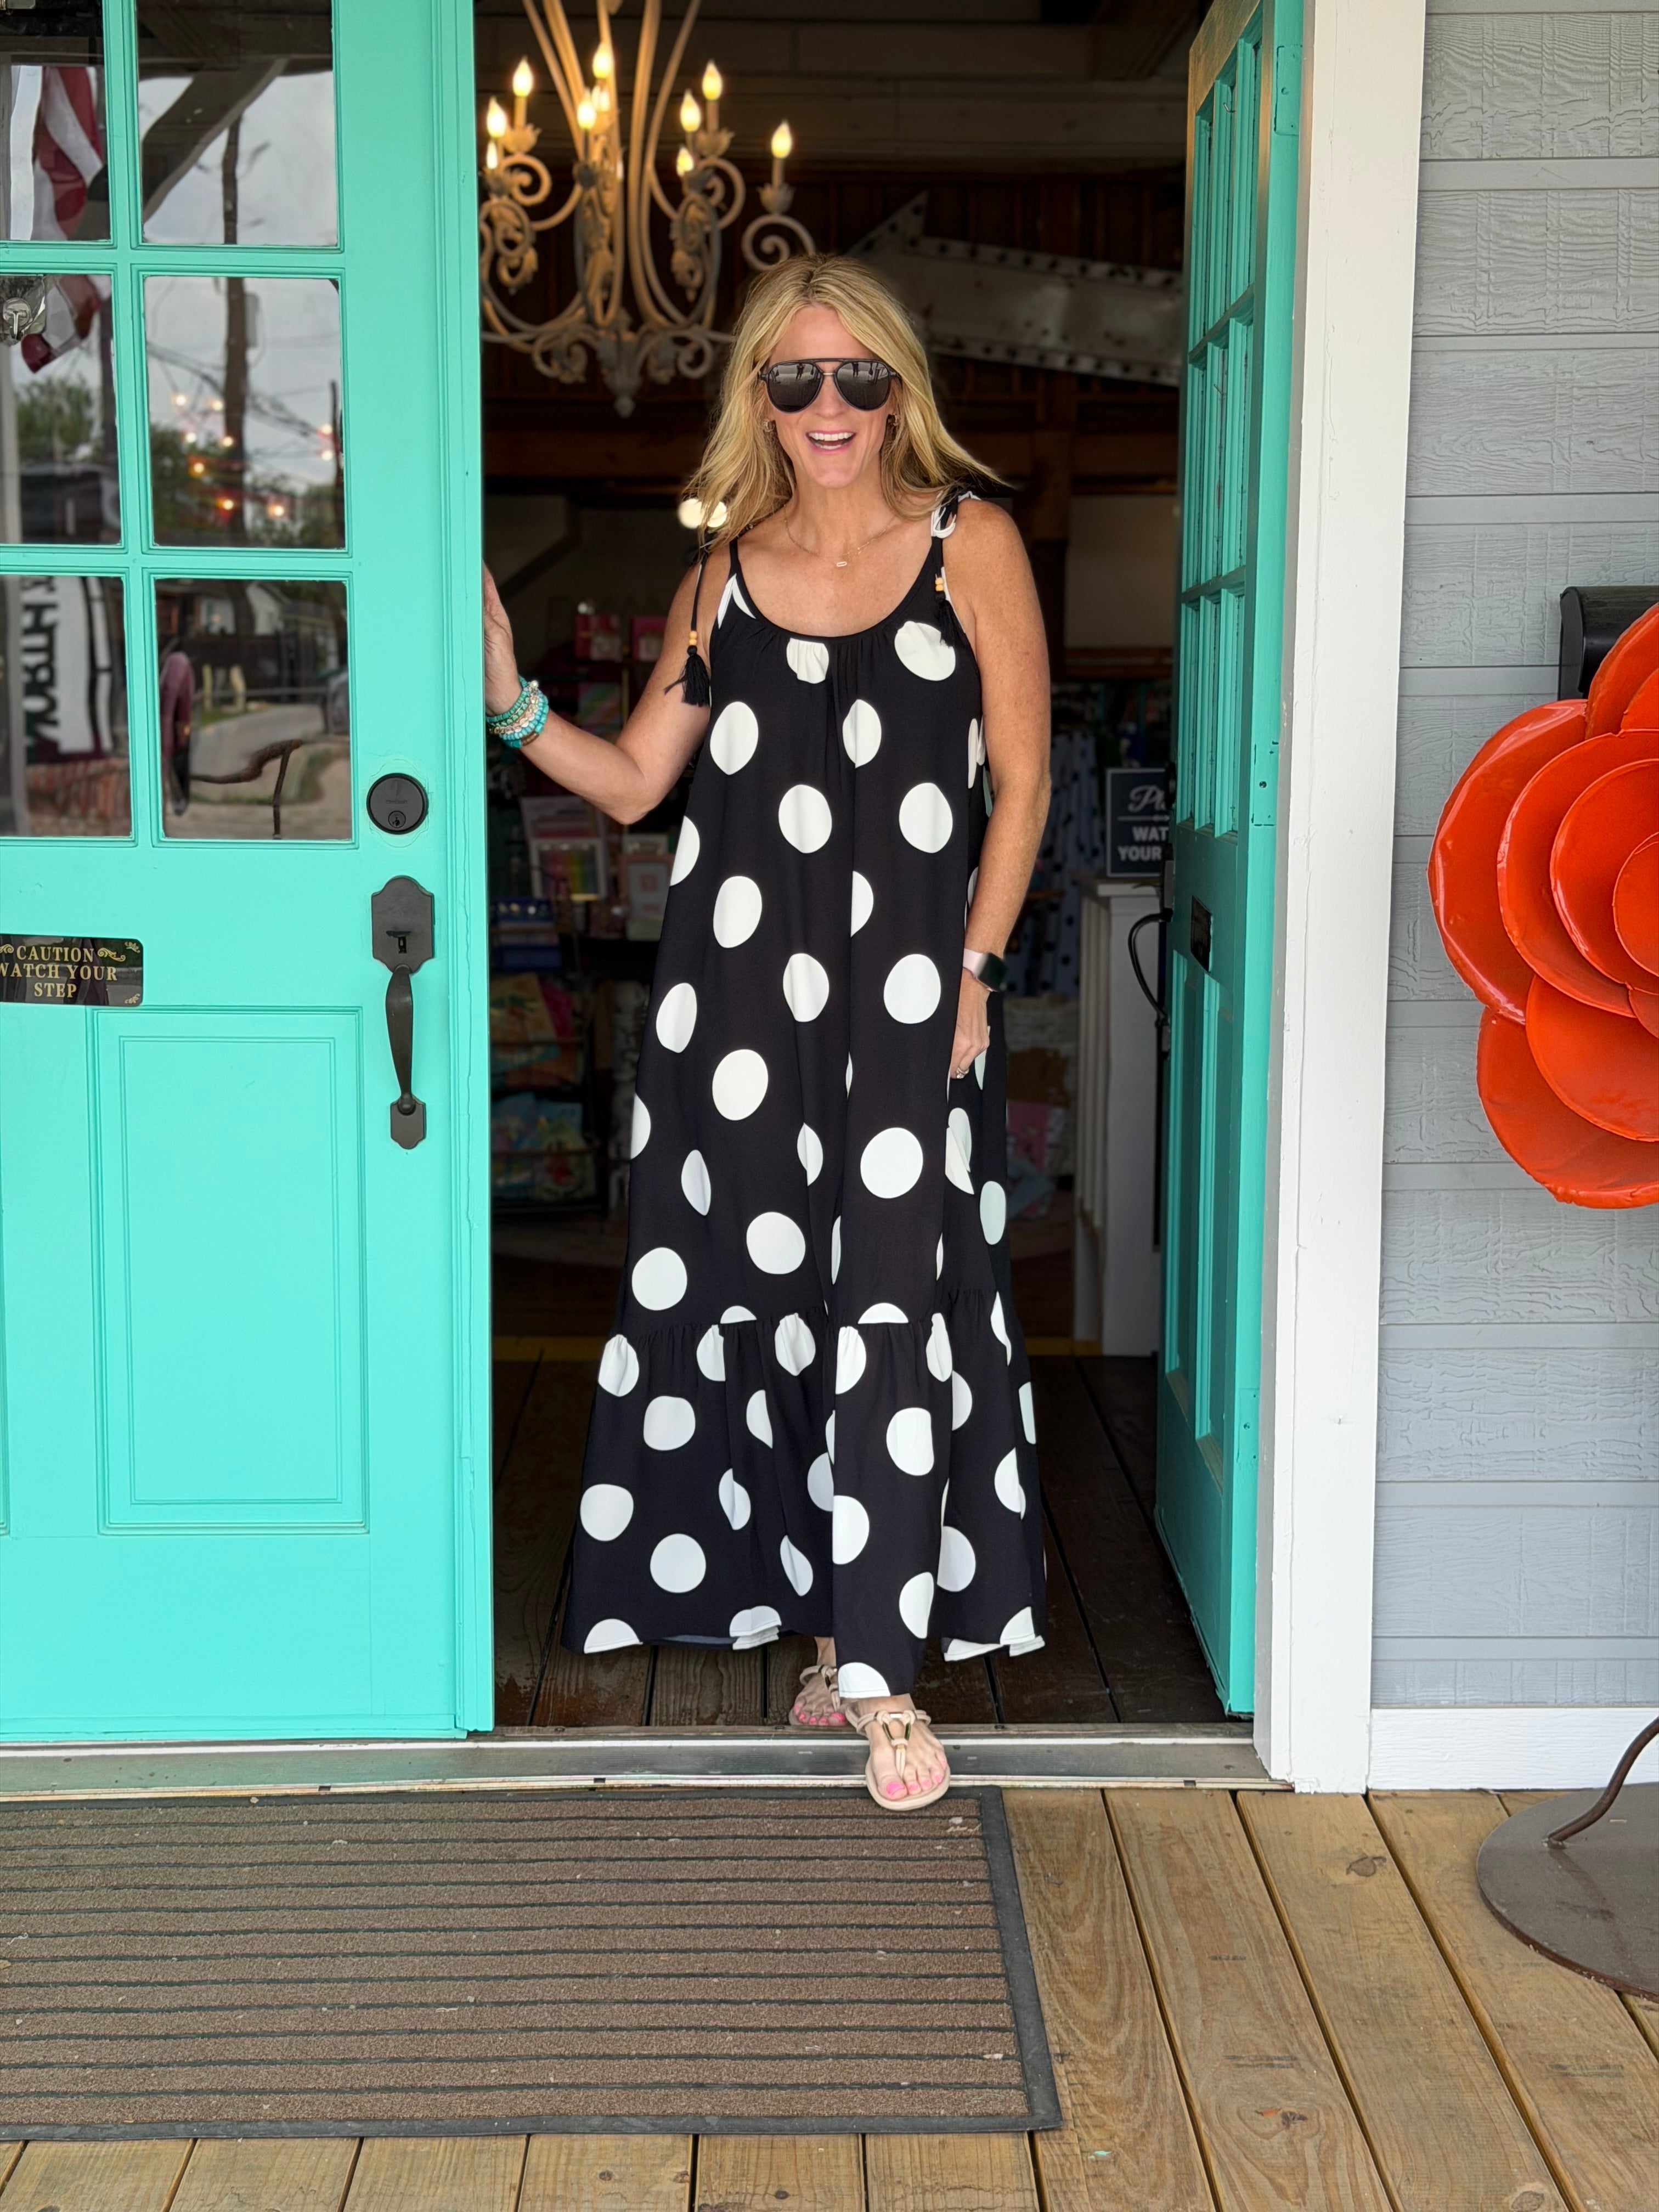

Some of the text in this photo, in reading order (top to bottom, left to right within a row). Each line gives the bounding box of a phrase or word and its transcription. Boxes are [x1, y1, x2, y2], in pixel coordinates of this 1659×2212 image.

[1132, 826, 1169, 842] WAT
[1117, 845, 1162, 861] YOUR
[16, 945, 94, 963] CAUTION
[0, 962, 118, 981] WATCH YOUR
[34, 982, 77, 998] STEP
